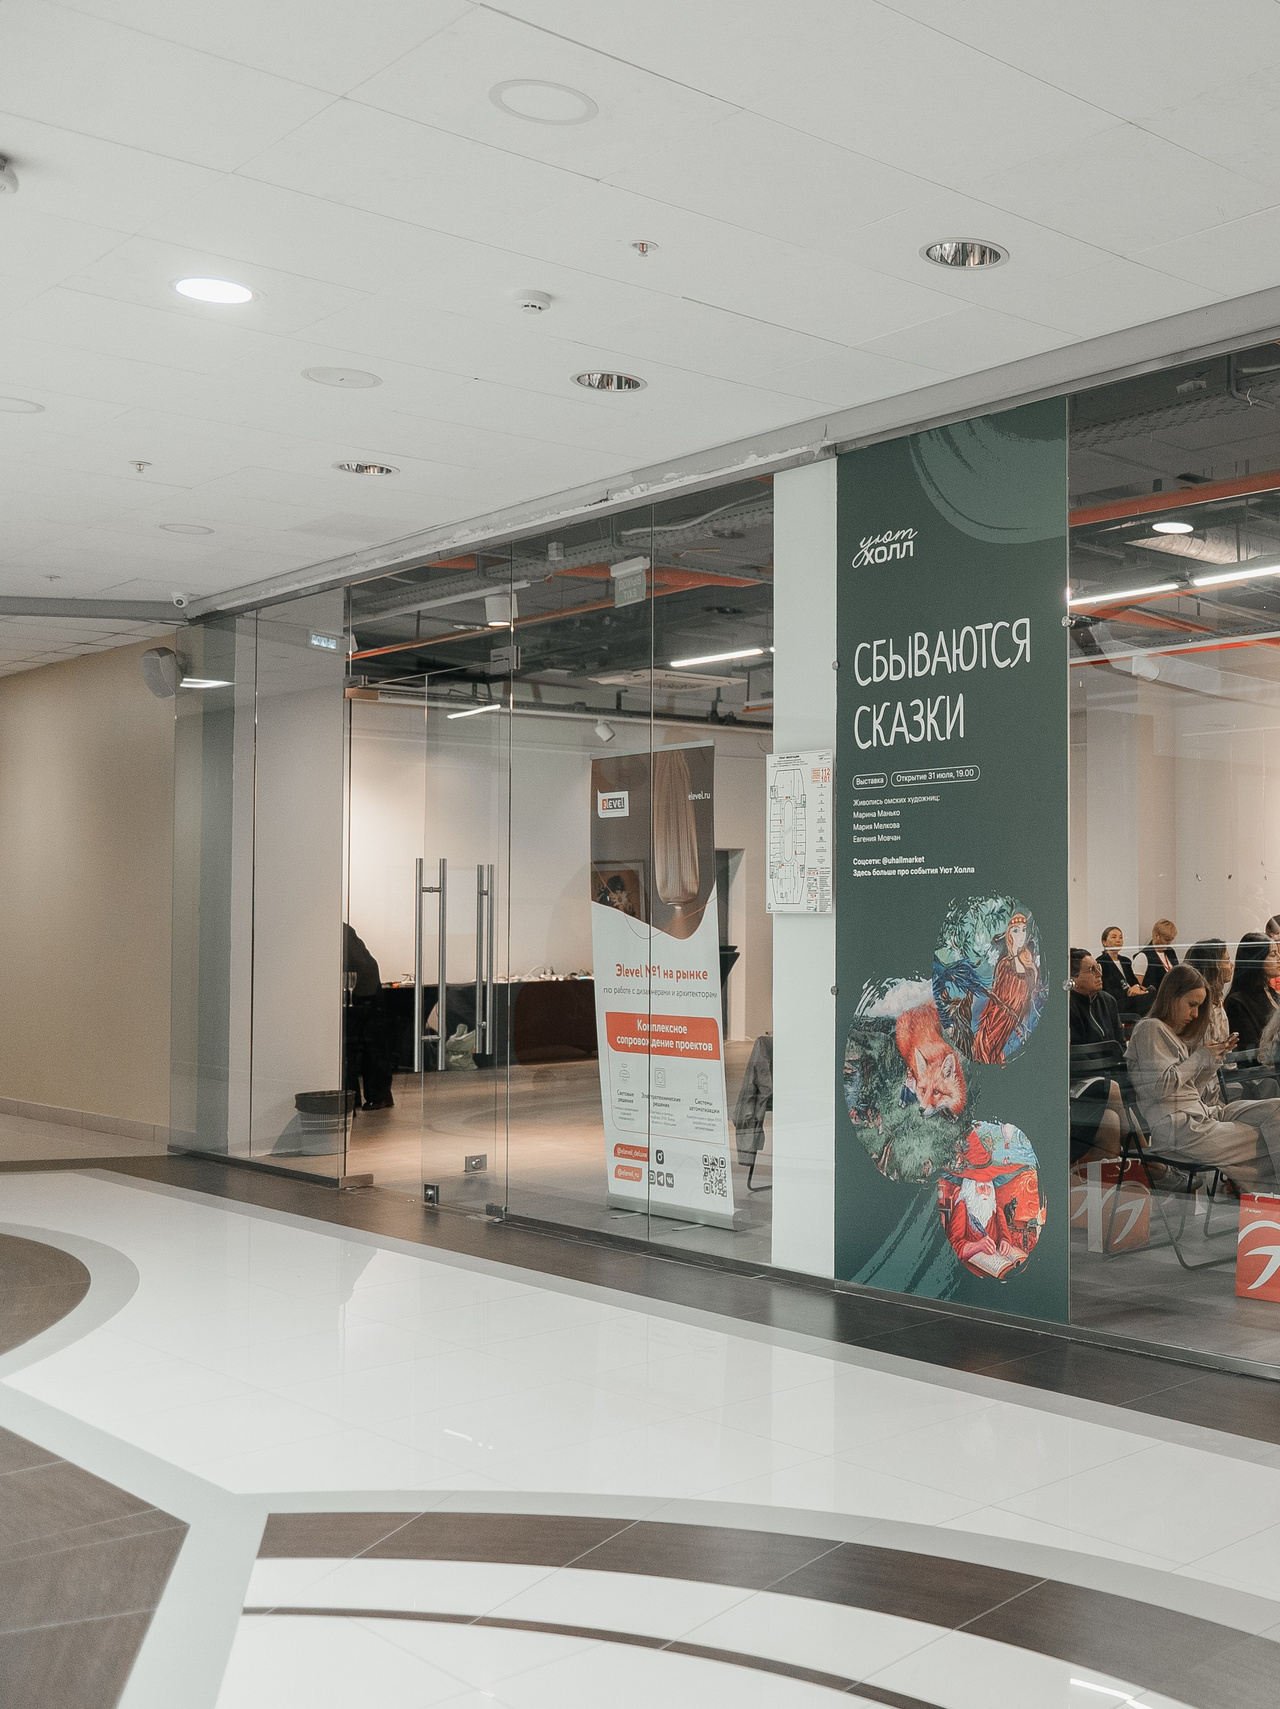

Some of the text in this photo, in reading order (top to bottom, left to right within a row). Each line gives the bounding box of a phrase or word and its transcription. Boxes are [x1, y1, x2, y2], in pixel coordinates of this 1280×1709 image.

[854, 618, 1031, 687] СБЫВАЮТСЯ
[854, 693, 964, 750] СКАЗКИ
[821, 767, 831, 776] 112
[896, 768, 975, 784] Открытие 31 июля, 19.00
[856, 777, 884, 786] Выставка
[688, 790, 711, 801] elevel.ru
[853, 798, 884, 807] Живопись
[853, 811, 877, 819] Марина
[853, 822, 900, 832] Мария Мелкова
[853, 834, 901, 843] Евгения Мовчан
[853, 856, 925, 867] Соцсети: @uhallmarket
[853, 866, 975, 877] Здесь больше про события Уют Холла
[663, 969, 674, 979] на
[676, 970, 708, 983] рынке
[614, 986, 631, 995] работе
[675, 1040, 713, 1052] проектов
[641, 1092, 681, 1102] Элетротехнические
